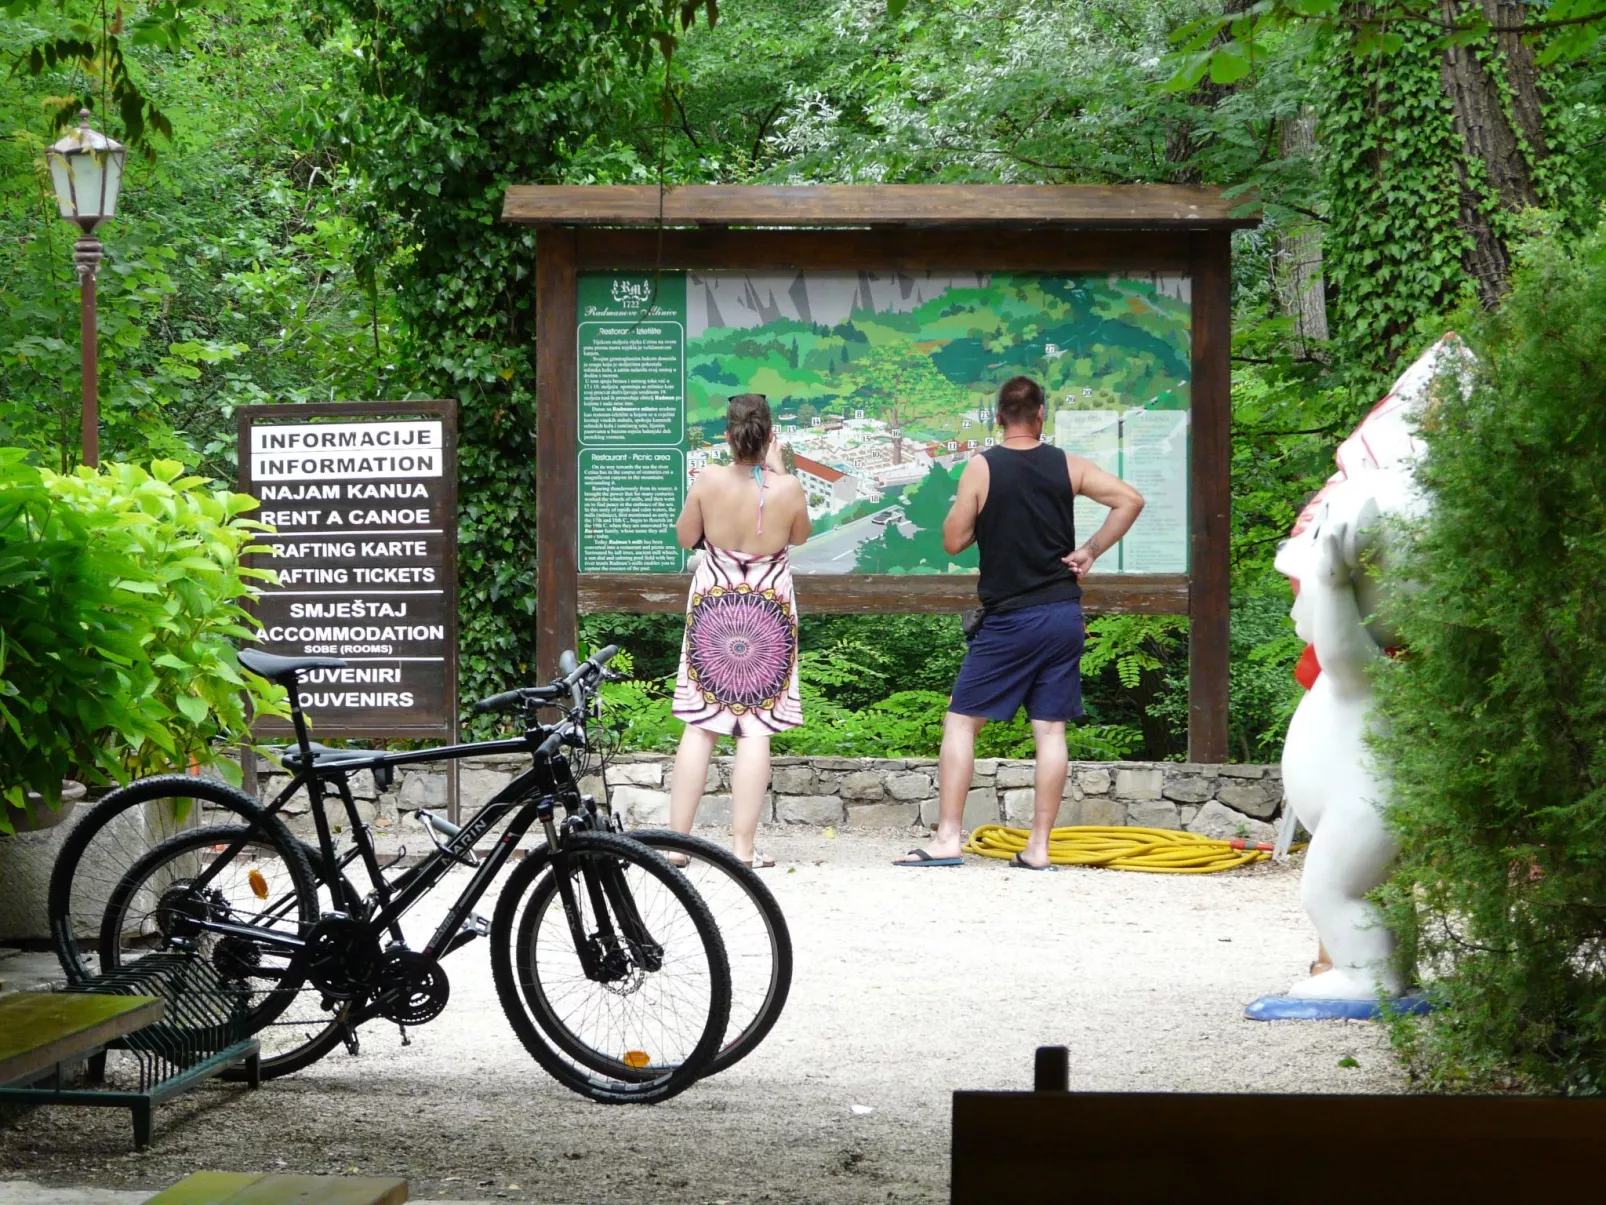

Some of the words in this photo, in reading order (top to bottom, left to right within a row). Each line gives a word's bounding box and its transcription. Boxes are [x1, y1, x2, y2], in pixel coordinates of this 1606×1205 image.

[584, 306, 638, 316] Radmanove
[262, 430, 432, 448] INFORMACIJE
[260, 456, 432, 474] INFORMATION
[262, 485, 340, 500] NAJAM
[348, 484, 428, 498] KANUA
[260, 510, 321, 525] RENT
[326, 511, 343, 525] A
[349, 509, 430, 524] CANOE
[272, 542, 355, 558] RAFTING
[361, 542, 427, 556] KARTE
[354, 568, 435, 582] TICKETS
[290, 600, 407, 618] SMJEŠTAJ
[256, 626, 444, 642] ACCOMMODATION
[304, 645, 338, 654] SOBE
[340, 644, 393, 654] (ROOMS)
[296, 668, 400, 684] SUVENIRI
[284, 692, 414, 708] OUVENIRS
